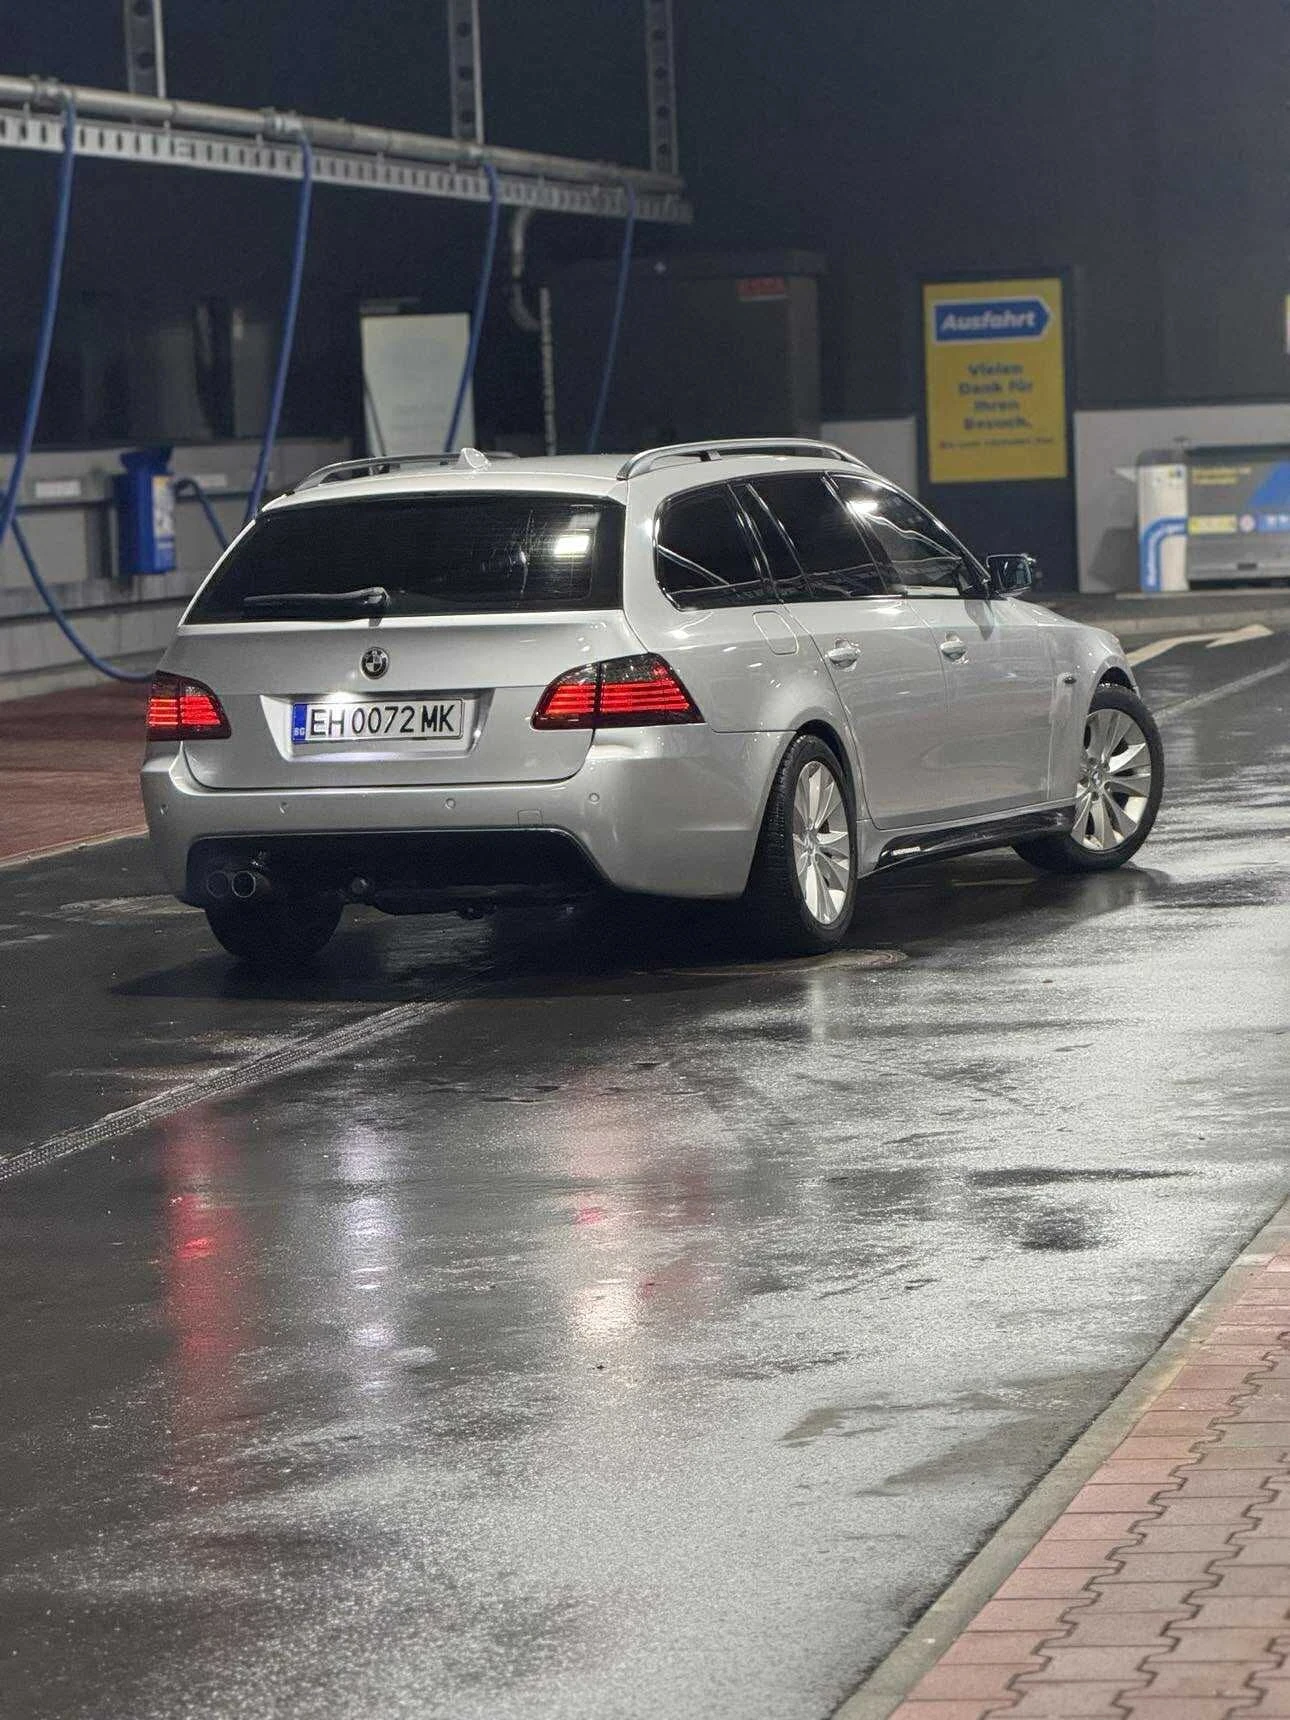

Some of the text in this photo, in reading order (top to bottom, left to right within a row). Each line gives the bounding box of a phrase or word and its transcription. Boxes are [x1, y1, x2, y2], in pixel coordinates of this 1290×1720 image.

[942, 309, 1036, 332] Ausfahrt
[968, 363, 1024, 376] Vielen
[960, 381, 1003, 396] Dank
[975, 400, 1020, 413] Ihren
[310, 704, 456, 736] EH 0072 MK
[294, 727, 306, 736] BG
